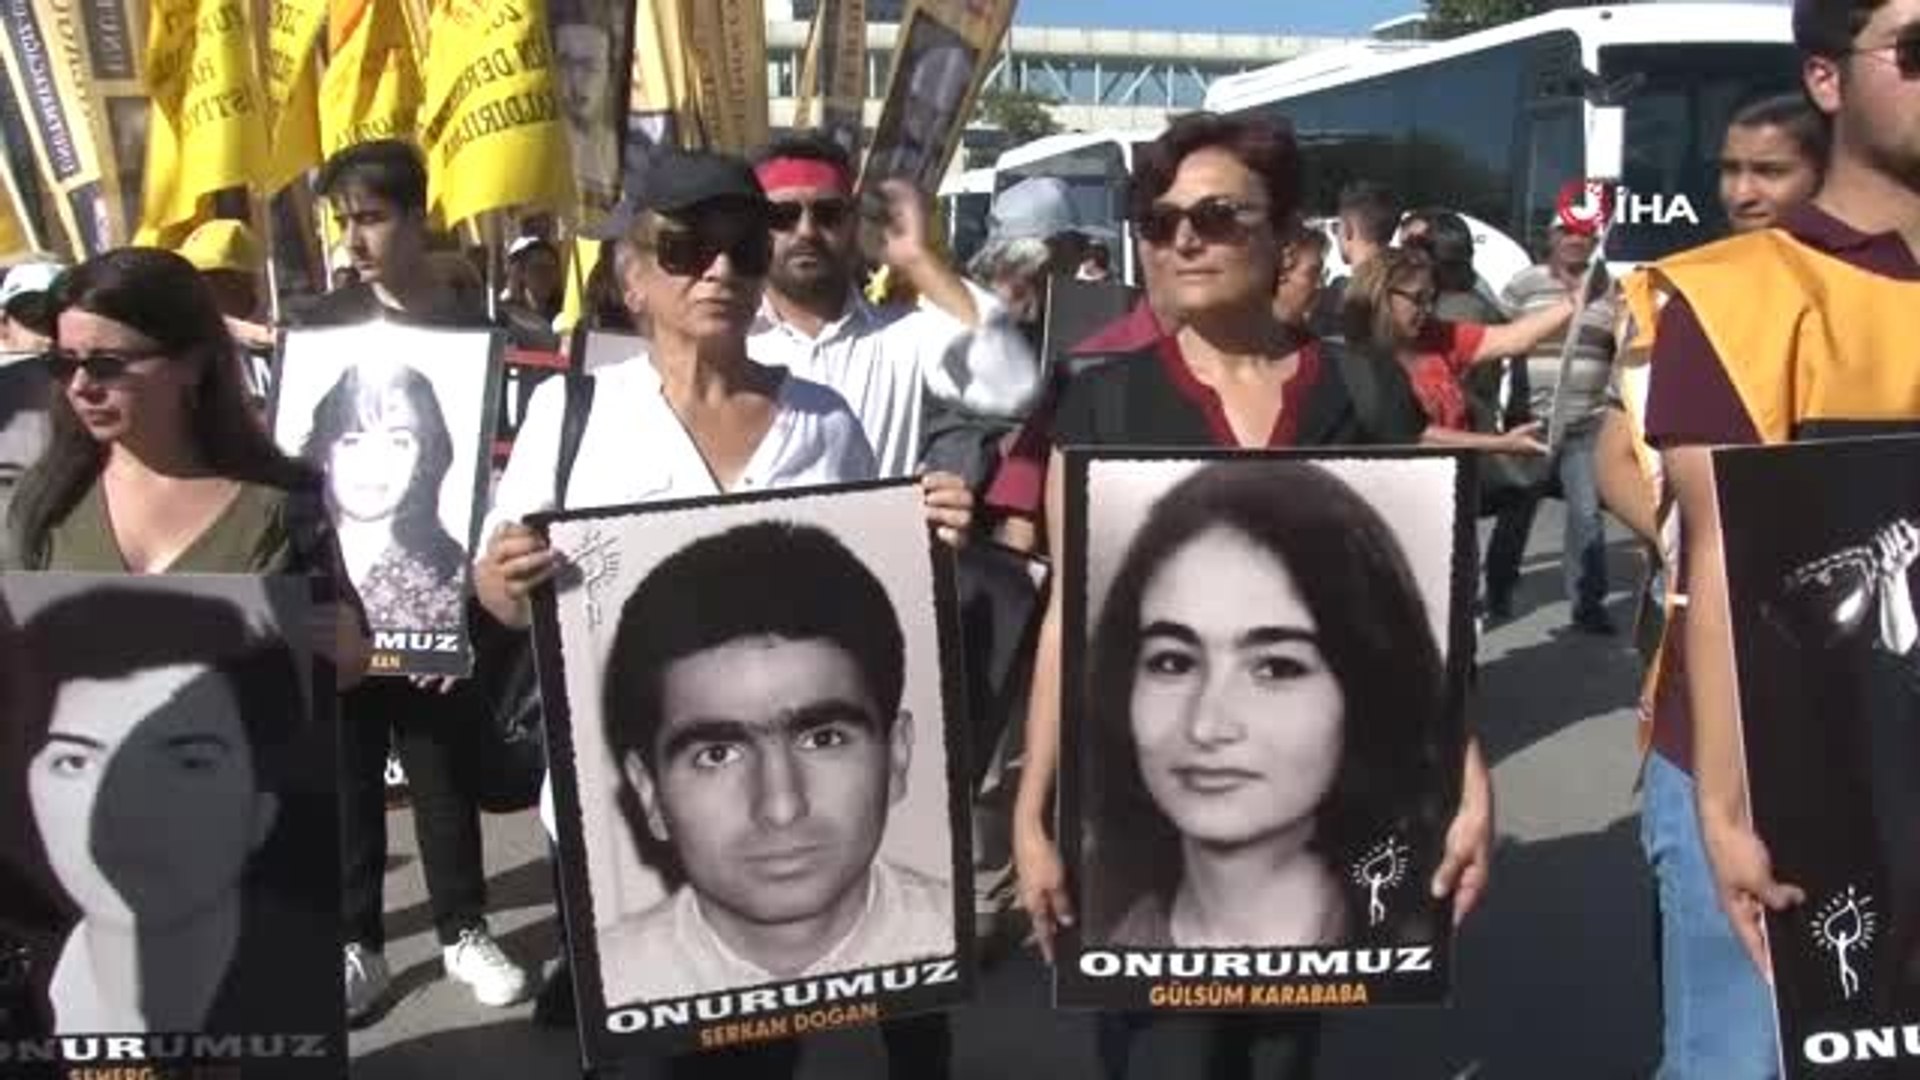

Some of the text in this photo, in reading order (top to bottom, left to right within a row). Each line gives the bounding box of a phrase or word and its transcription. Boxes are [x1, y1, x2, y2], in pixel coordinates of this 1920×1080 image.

[1080, 947, 1432, 976] ONURUMUZ
[606, 959, 958, 1034] ONURUMUZ
[1250, 983, 1368, 1005] KARABABA
[701, 1016, 788, 1047] SERKAN
[0, 1036, 328, 1061] NURUMUZ
